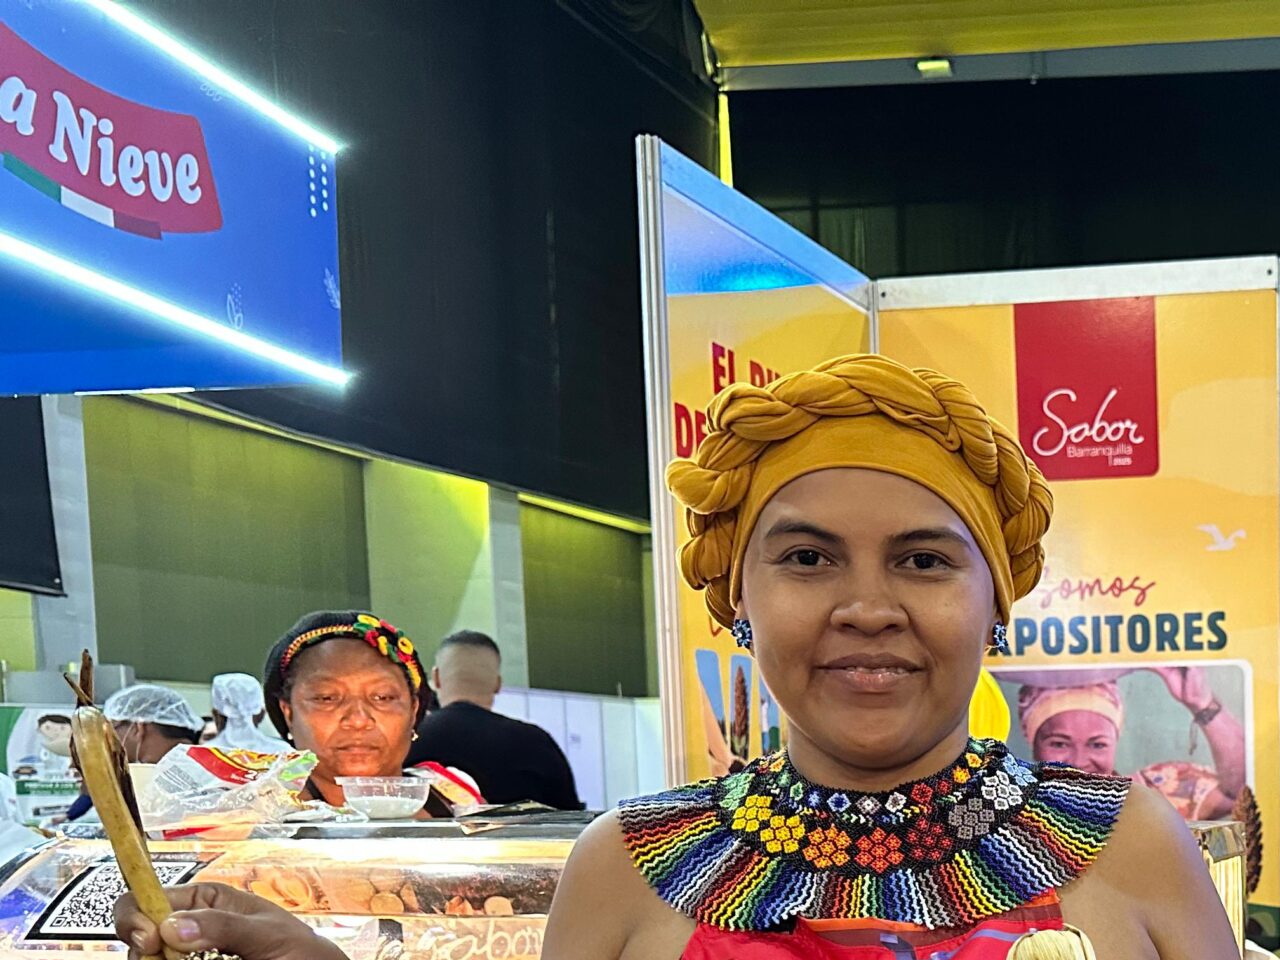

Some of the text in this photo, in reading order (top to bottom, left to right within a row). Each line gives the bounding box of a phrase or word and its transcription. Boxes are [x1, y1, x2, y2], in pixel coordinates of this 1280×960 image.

[49, 91, 201, 204] Nieve
[1033, 388, 1144, 456] Sabor
[1066, 443, 1133, 466] Barranquilla
[988, 611, 1227, 656] POSITORES
